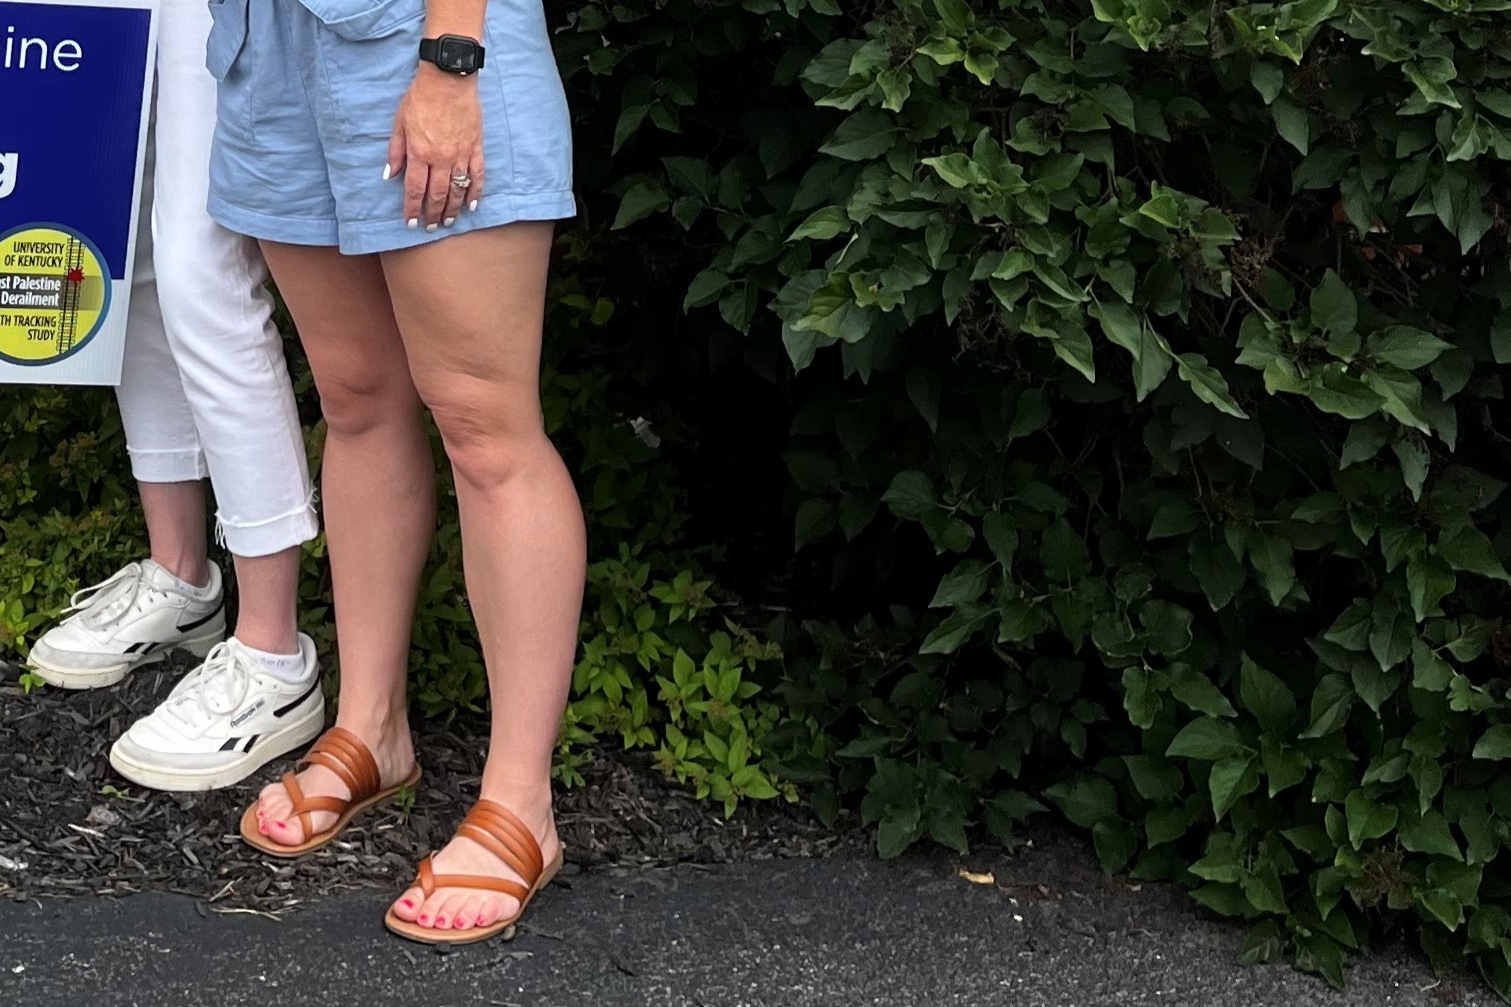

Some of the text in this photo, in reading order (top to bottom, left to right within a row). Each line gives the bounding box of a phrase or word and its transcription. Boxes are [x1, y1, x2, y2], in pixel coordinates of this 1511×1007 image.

[14, 241, 65, 254] UNIVERSITY
[5, 255, 63, 267] OF KENTUCKY
[13, 275, 61, 291] Palestine
[1, 291, 59, 306] Derailment
[14, 315, 56, 328] TRACKING
[28, 329, 55, 341] STUDY
